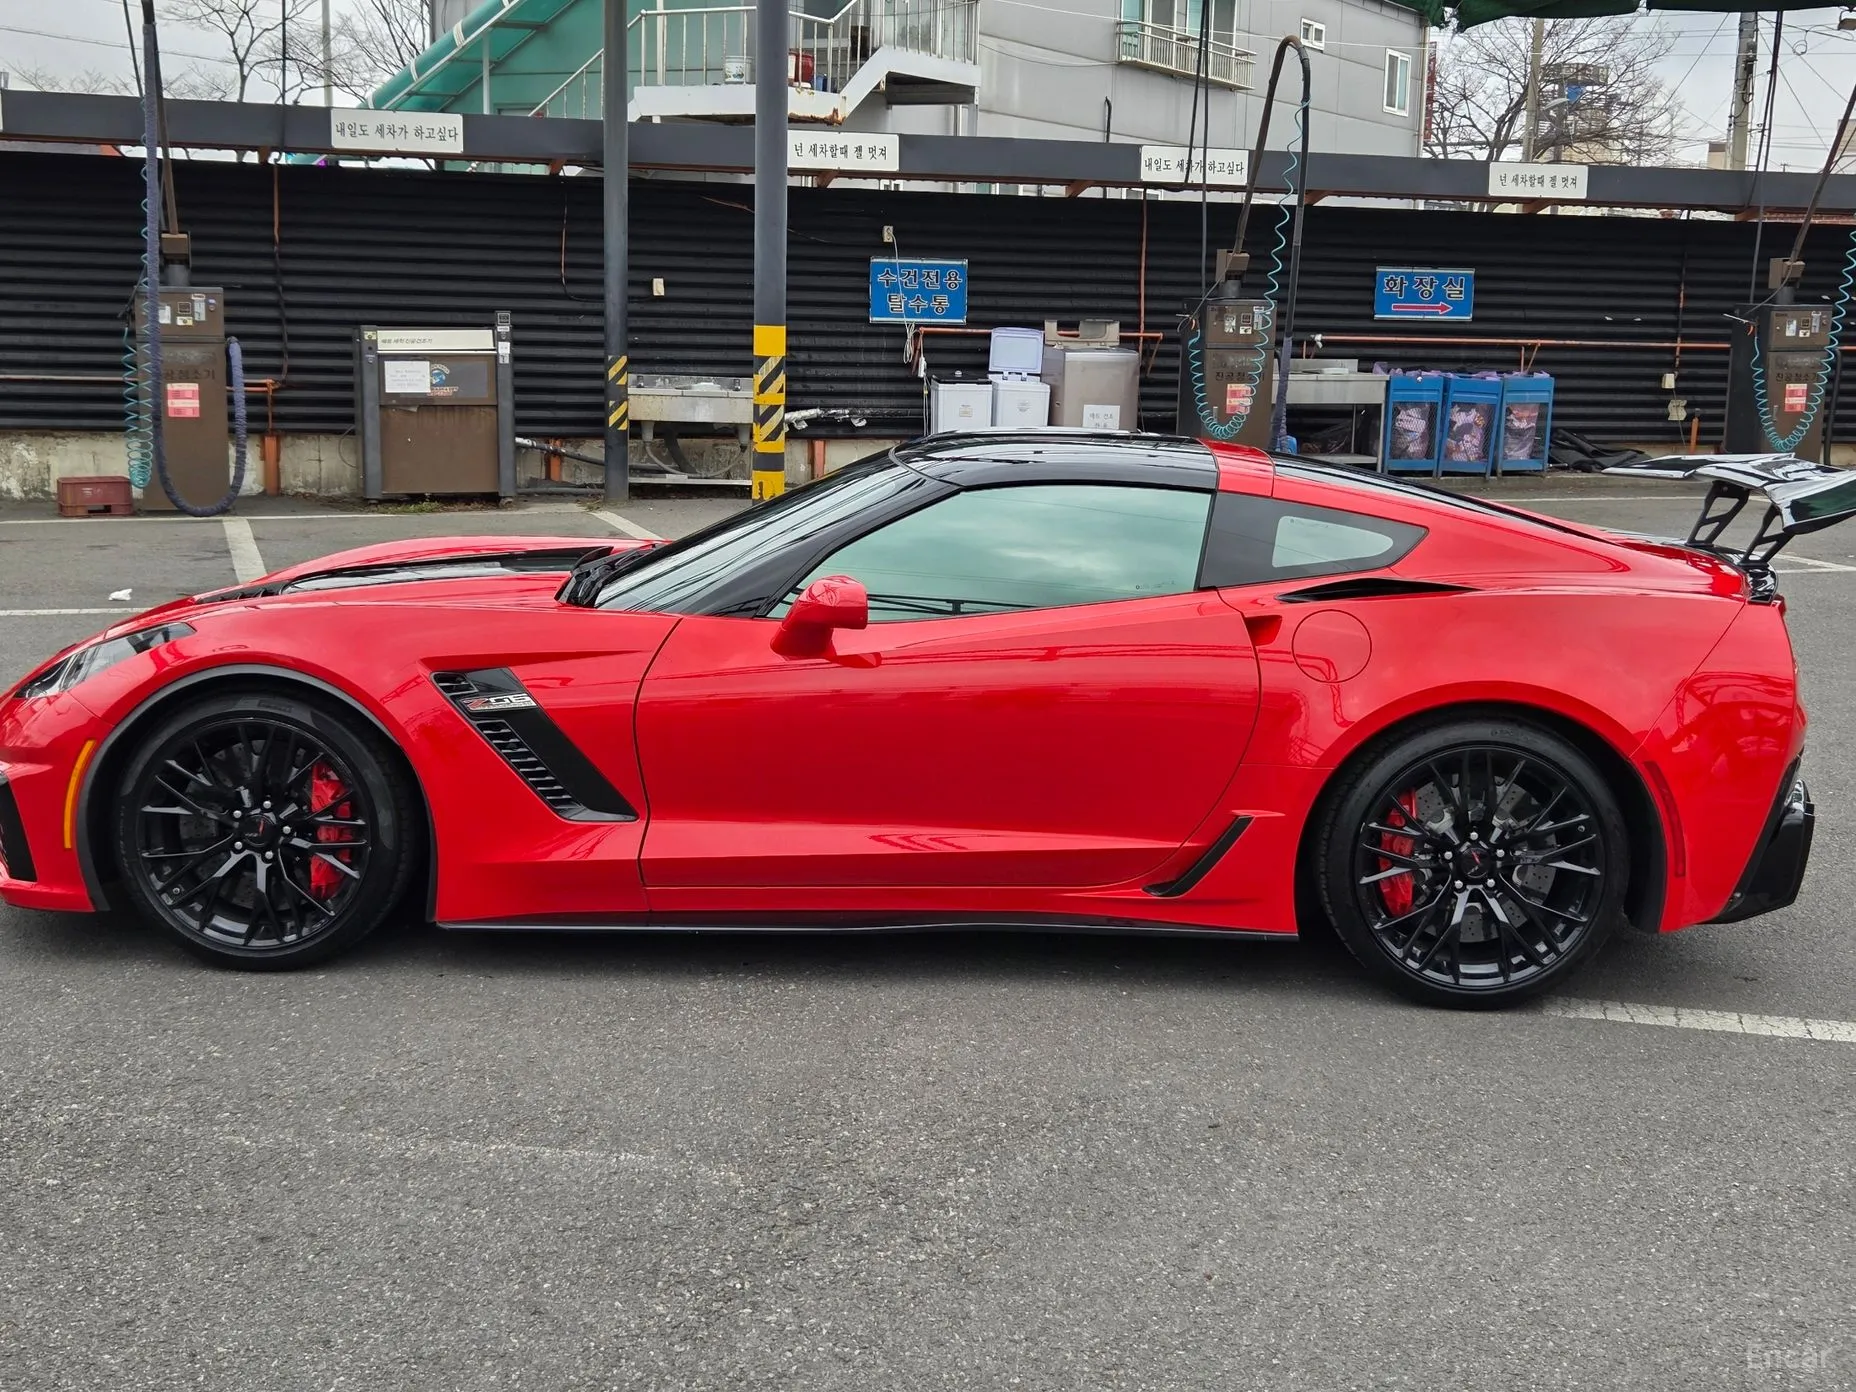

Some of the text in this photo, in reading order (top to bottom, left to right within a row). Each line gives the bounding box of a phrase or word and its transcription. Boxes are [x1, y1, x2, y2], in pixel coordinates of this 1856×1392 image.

[335, 122, 459, 142] 내일도 세차가 하고싶다
[794, 142, 803, 157] 넌
[808, 143, 848, 159] 세차할때
[868, 145, 888, 160] 멋져
[1144, 158, 1172, 172] 내일도
[1207, 160, 1245, 175] 하고싶다
[1499, 173, 1507, 187] 넌
[1511, 173, 1545, 189] 세차할때
[877, 267, 963, 291] 수건전용
[1383, 274, 1466, 301] 화장실
[886, 292, 950, 316] 탈수통
[163, 367, 216, 381] 공청소기
